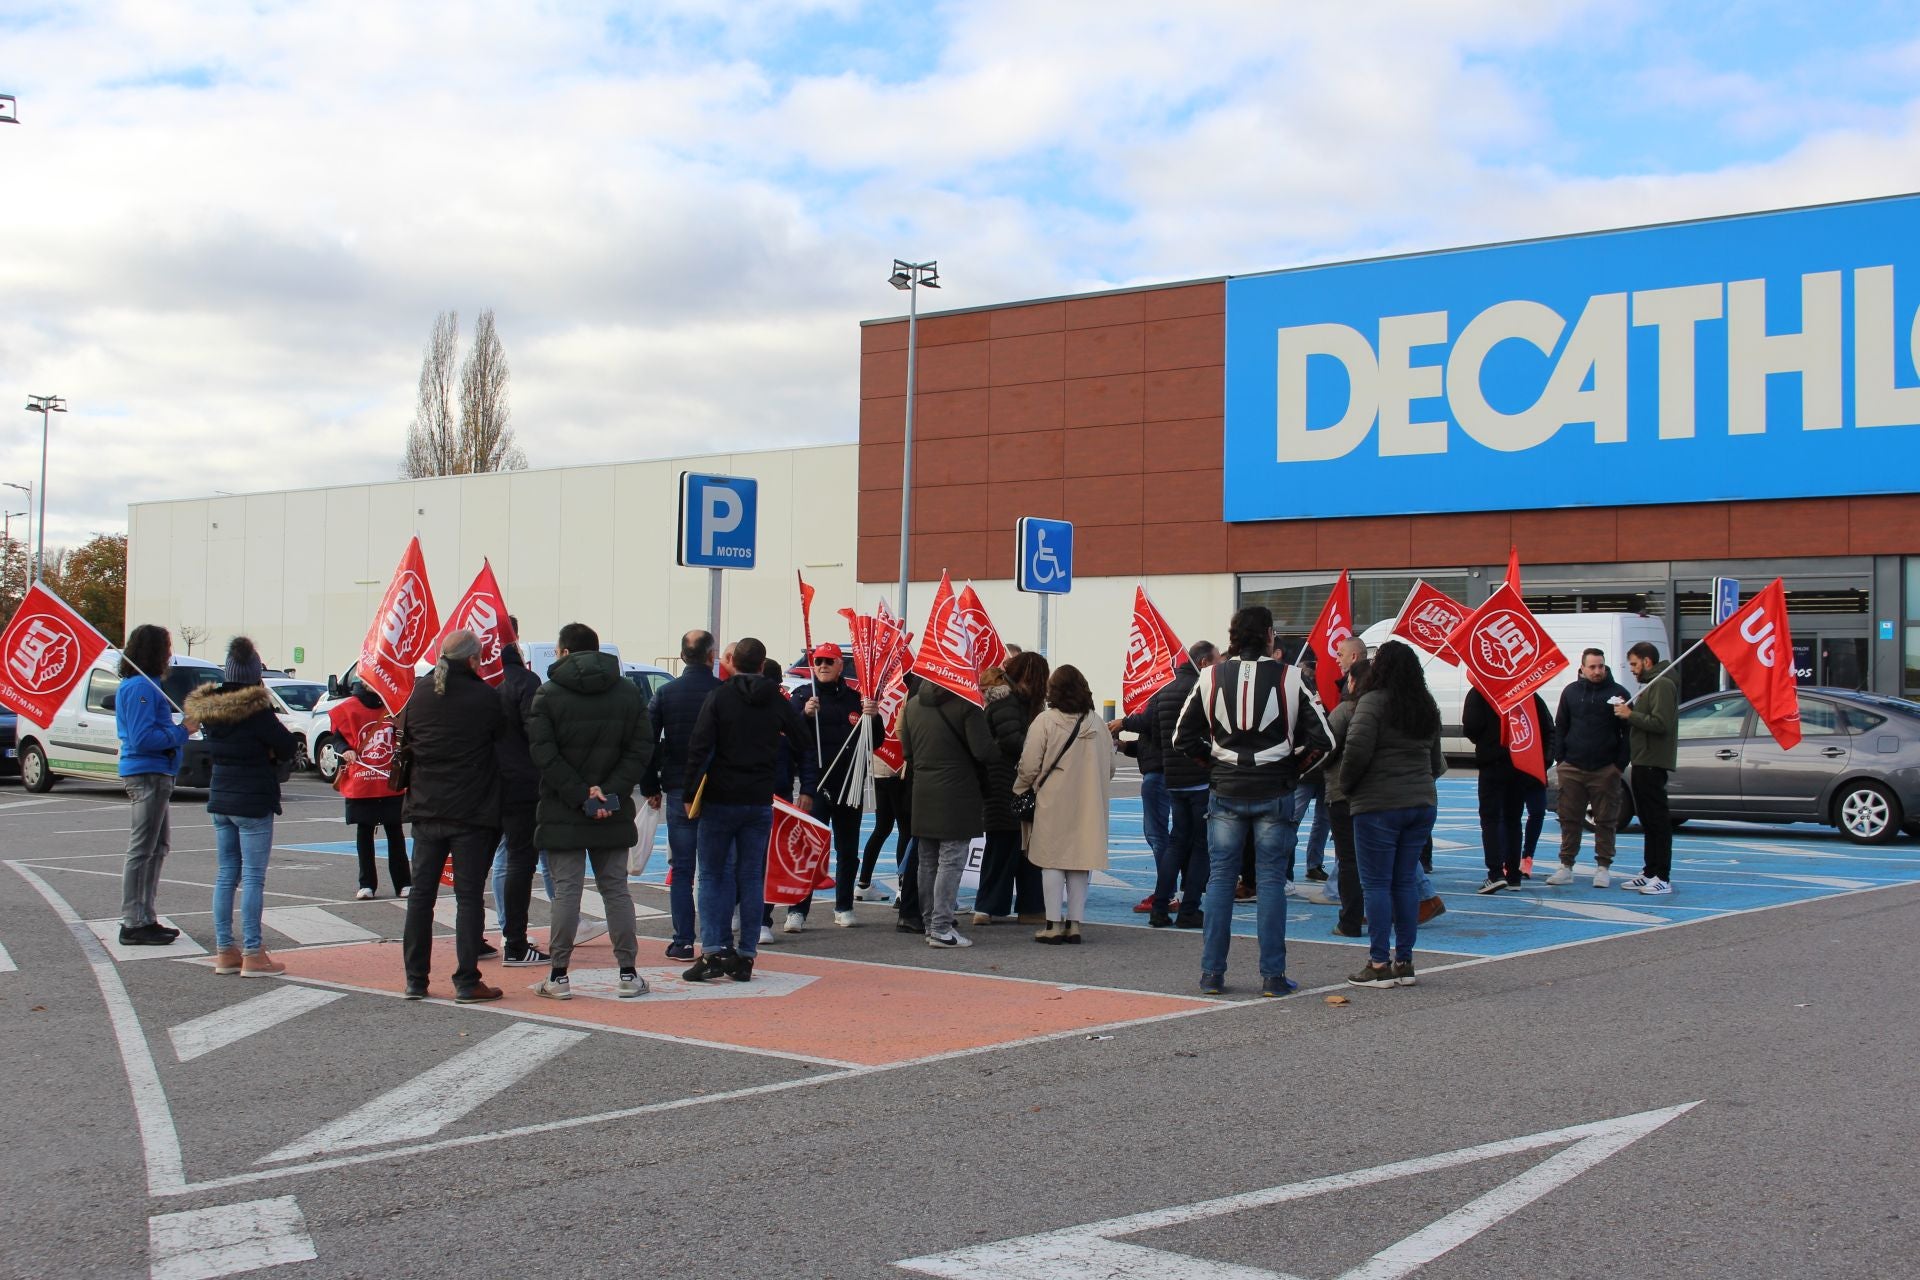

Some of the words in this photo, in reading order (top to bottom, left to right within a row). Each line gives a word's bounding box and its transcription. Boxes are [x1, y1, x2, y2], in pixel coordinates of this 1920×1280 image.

[1277, 264, 1920, 463] DECATHL
[701, 486, 743, 556] P
[717, 546, 752, 558] MOTOS
[382, 577, 421, 646] UGT
[1416, 602, 1461, 634] UGT
[10, 619, 60, 681] UGT
[1487, 614, 1535, 668] UGT
[926, 661, 980, 692] www.ugt.es
[1124, 671, 1165, 704] www.ugt.es
[1505, 660, 1556, 698] www.ugt.es
